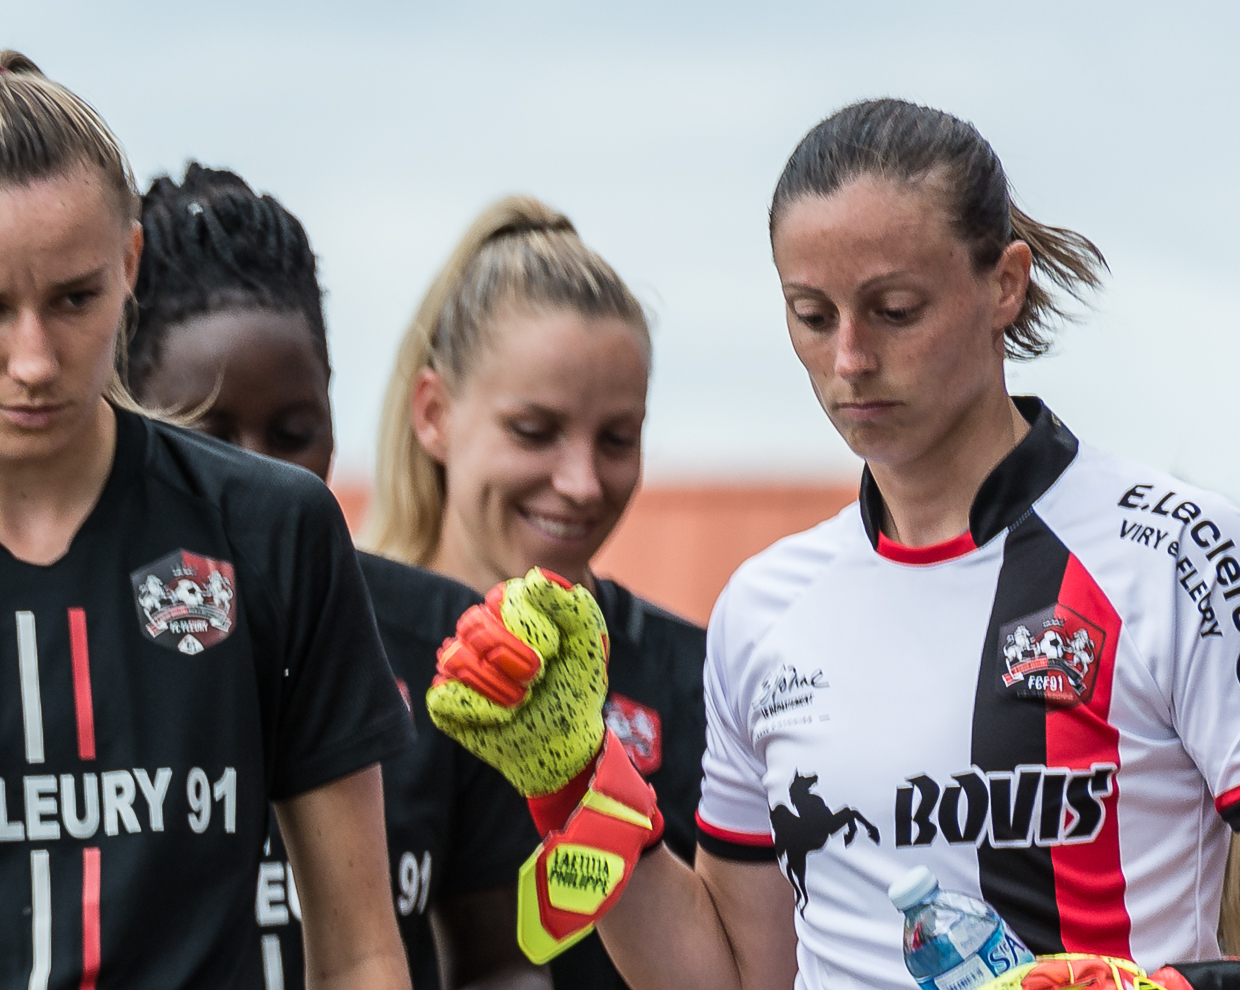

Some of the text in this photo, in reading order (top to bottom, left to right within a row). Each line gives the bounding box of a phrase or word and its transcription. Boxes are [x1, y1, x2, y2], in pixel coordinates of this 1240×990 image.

[1119, 518, 1169, 550] VIRY
[186, 766, 237, 835] 91
[895, 765, 1115, 847] BOVIS
[396, 850, 432, 917] 91
